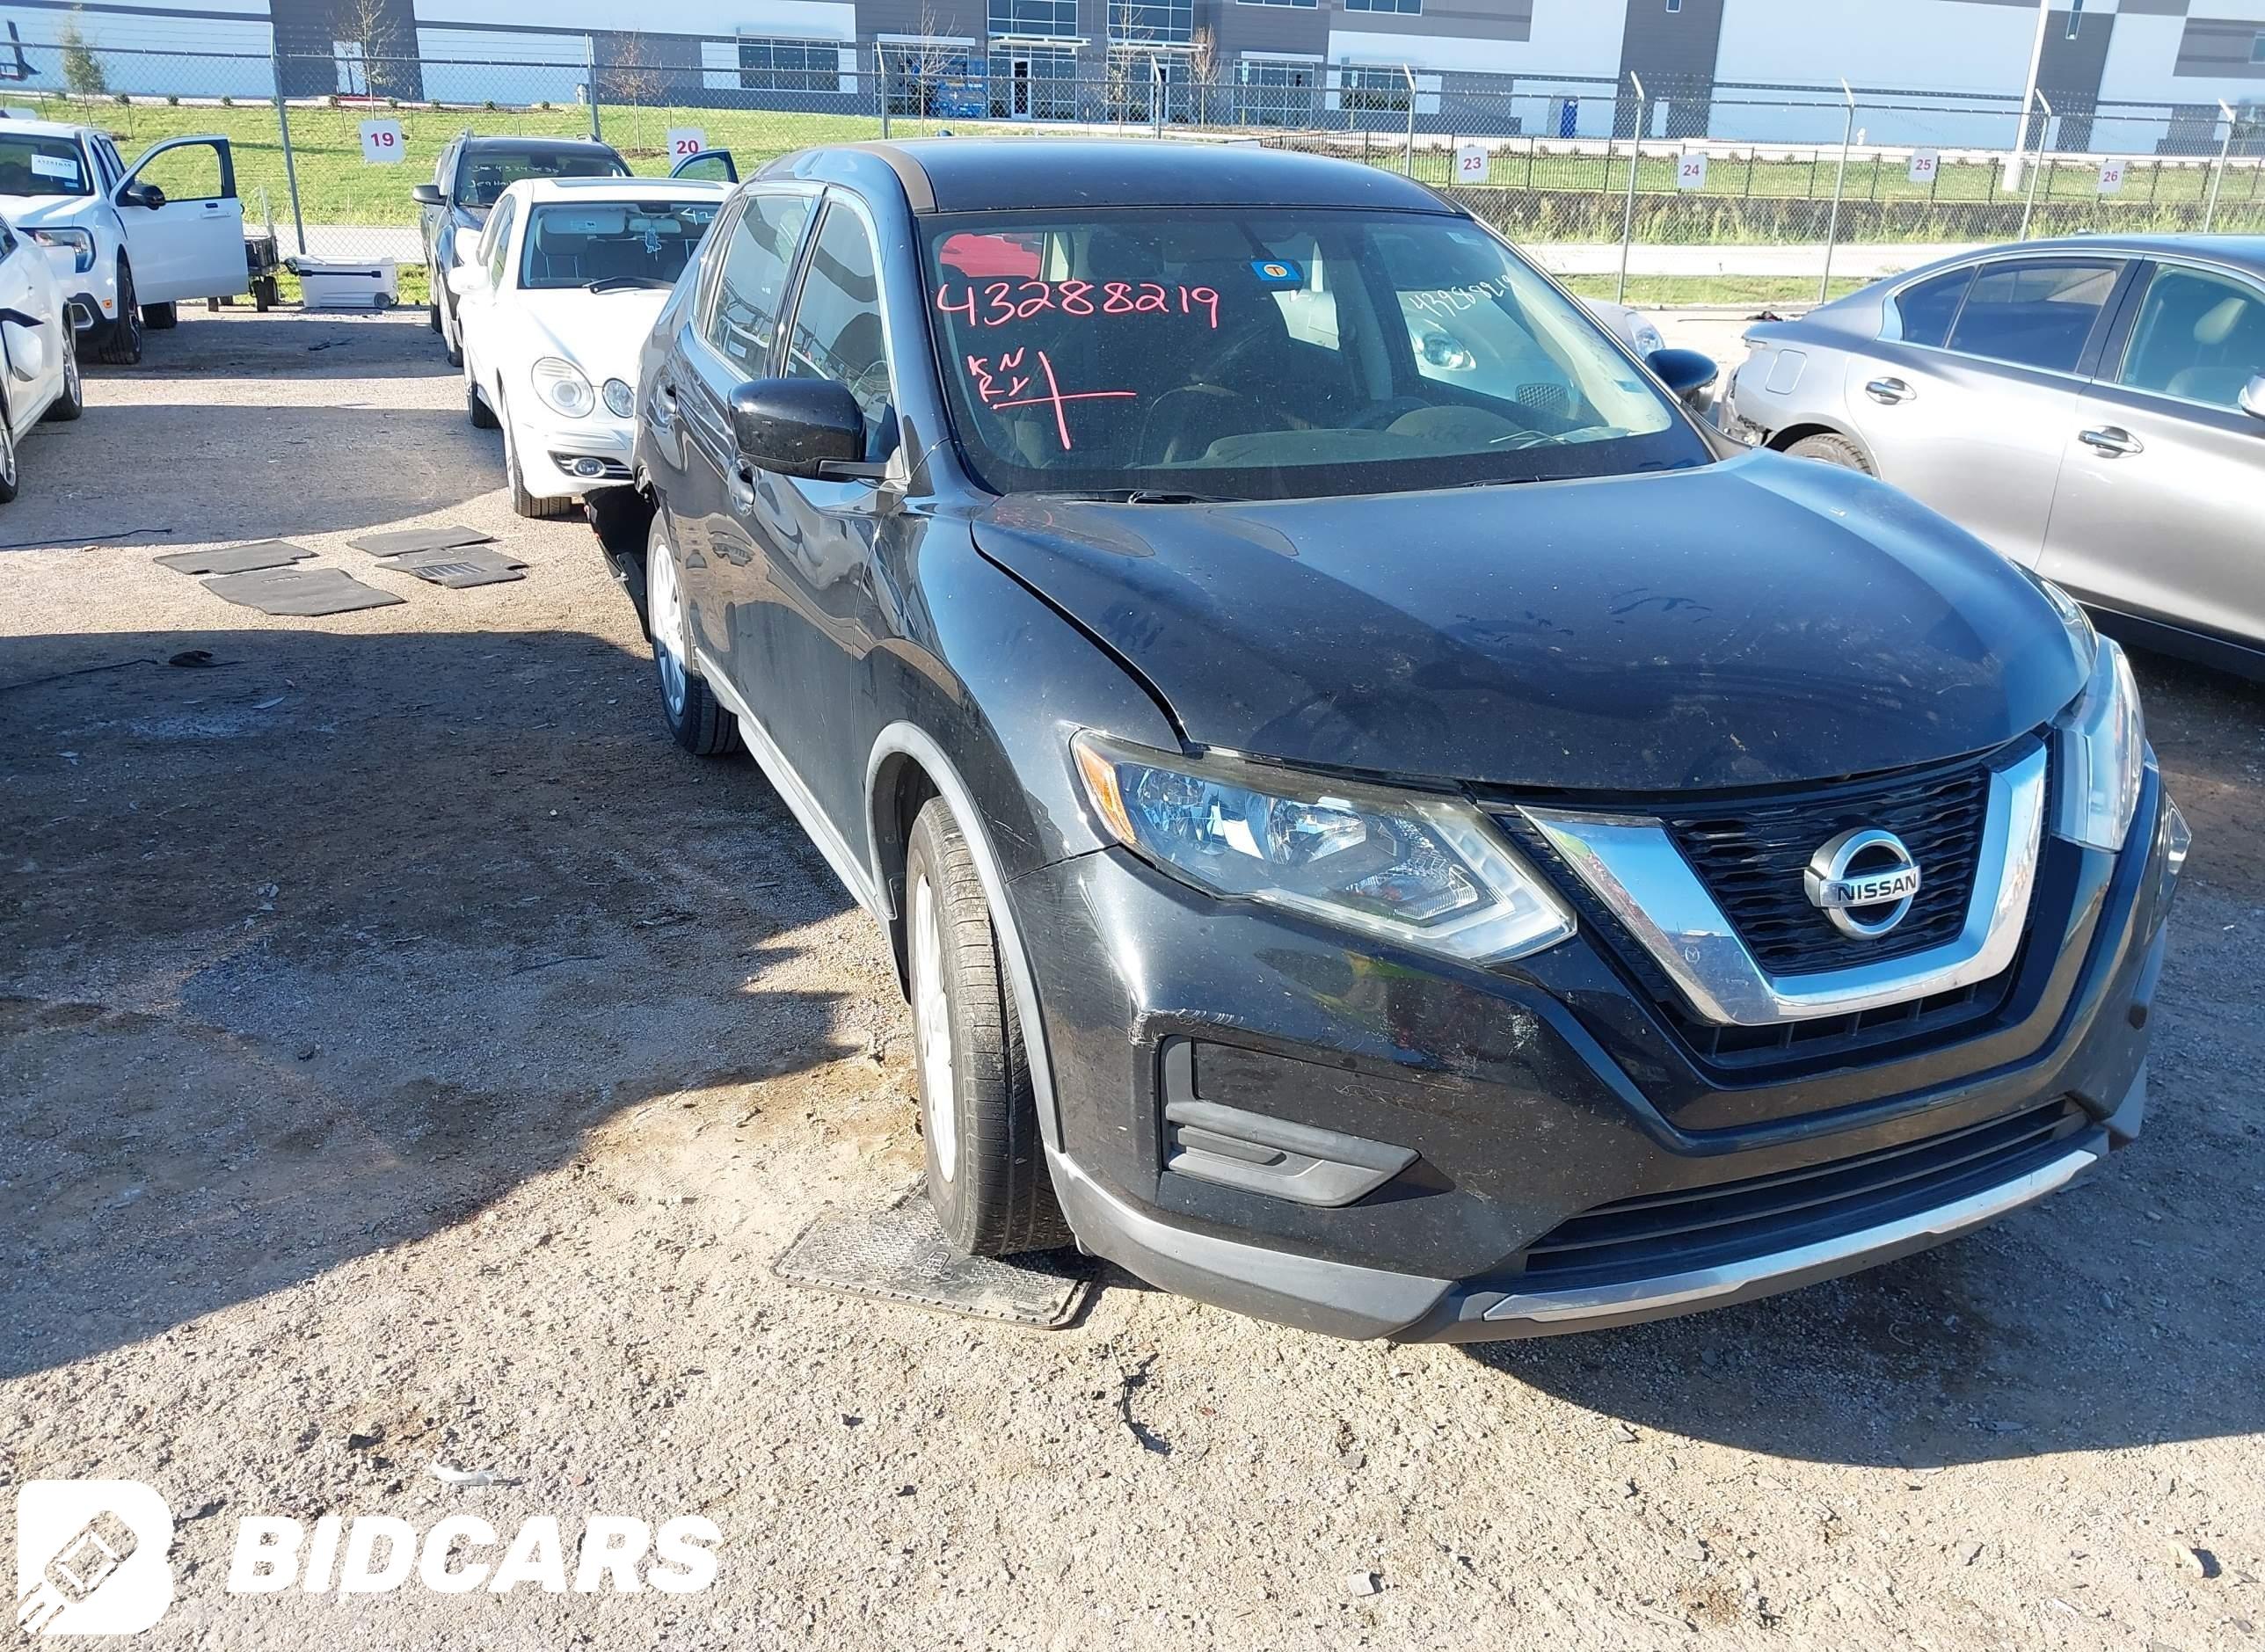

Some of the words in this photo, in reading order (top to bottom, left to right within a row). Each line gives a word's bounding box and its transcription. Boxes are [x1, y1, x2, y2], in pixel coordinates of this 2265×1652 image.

[370, 132, 395, 148] 19
[675, 140, 700, 155] 20
[1463, 156, 1482, 171] 23
[1682, 164, 1701, 178] 24
[1914, 158, 1932, 171] 25
[2102, 170, 2119, 183] 26
[936, 280, 1220, 330] 43288219
[1837, 872, 1917, 902] NISSAN
